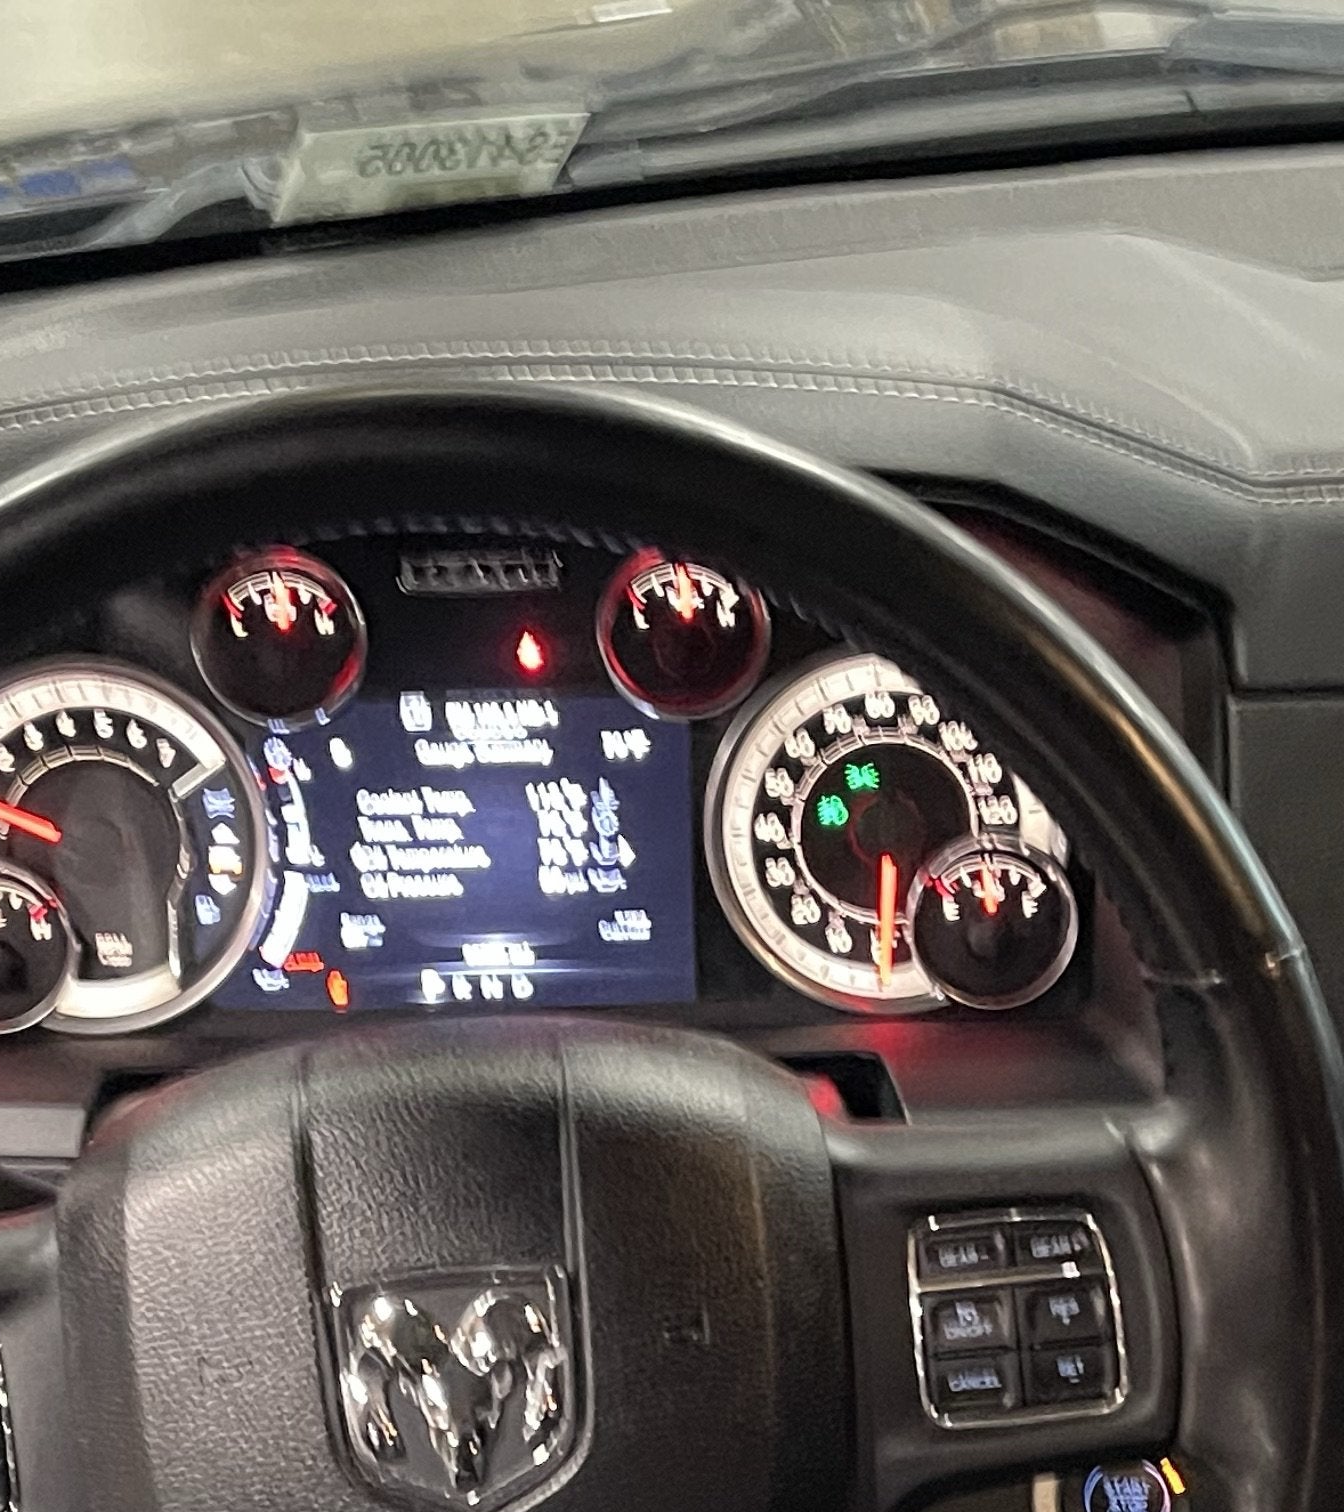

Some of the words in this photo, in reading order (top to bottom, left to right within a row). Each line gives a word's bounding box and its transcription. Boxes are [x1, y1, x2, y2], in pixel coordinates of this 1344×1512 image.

[822, 702, 852, 735] 70
[864, 692, 896, 719] 80
[908, 694, 941, 725] 90
[784, 727, 816, 759] 60
[764, 766, 795, 799] 50
[967, 752, 1003, 784] 110
[356, 788, 423, 815] Coolant
[978, 794, 1018, 825] 120
[754, 811, 787, 843] 40
[386, 844, 492, 873] Temperature
[764, 856, 796, 888] 30
[386, 871, 465, 898] Pressure
[790, 893, 822, 925] 20
